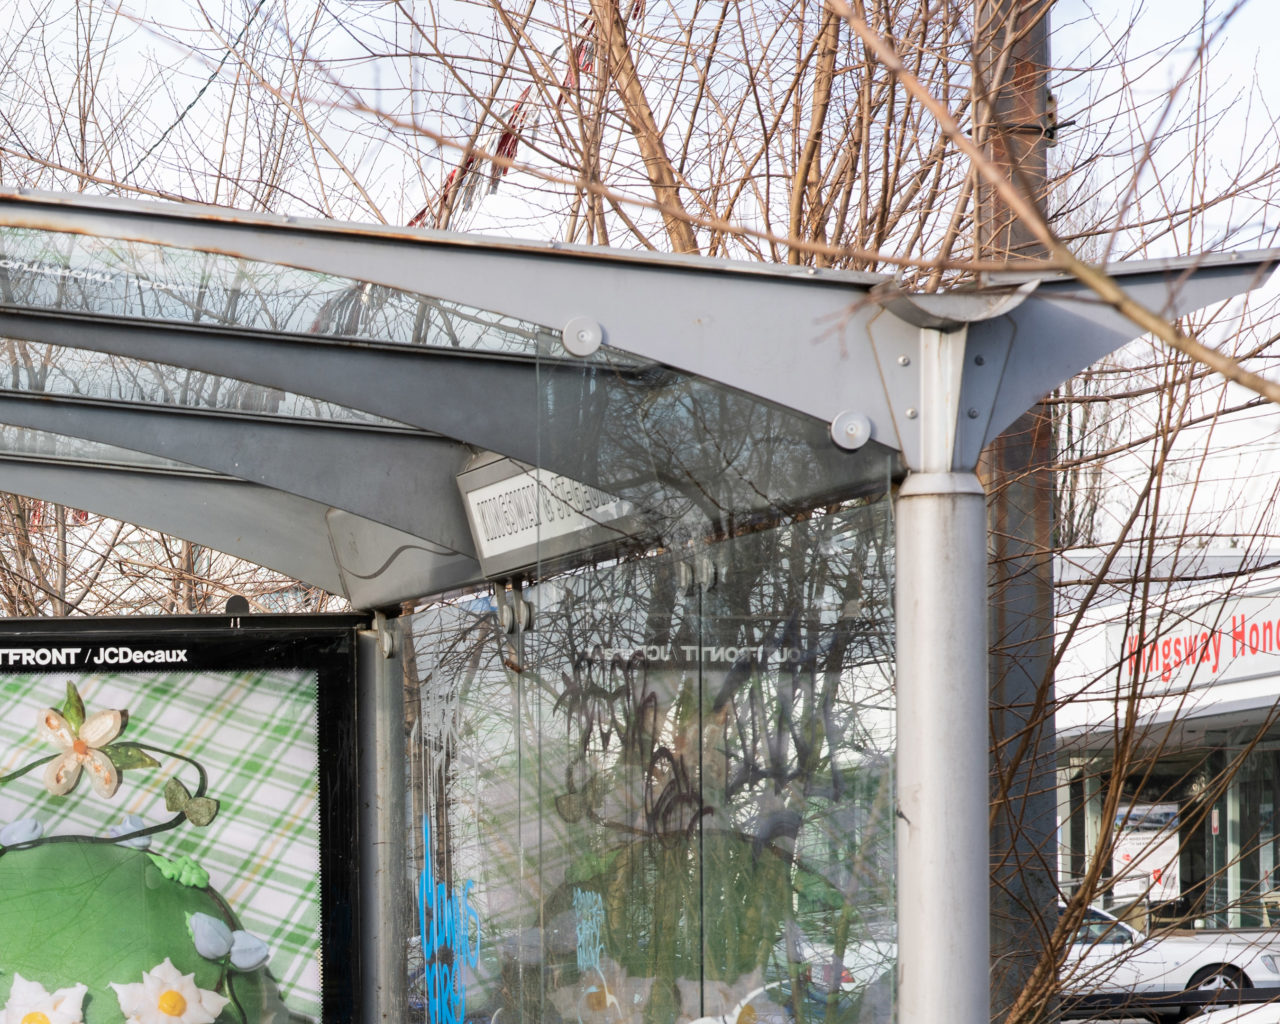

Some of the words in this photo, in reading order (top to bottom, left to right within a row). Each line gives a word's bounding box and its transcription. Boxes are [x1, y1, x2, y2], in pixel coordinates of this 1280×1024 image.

[476, 483, 542, 542] KINGSWAY
[539, 484, 555, 521] &
[93, 647, 188, 665] JCDecaux
[1128, 628, 1223, 683] Kingsway
